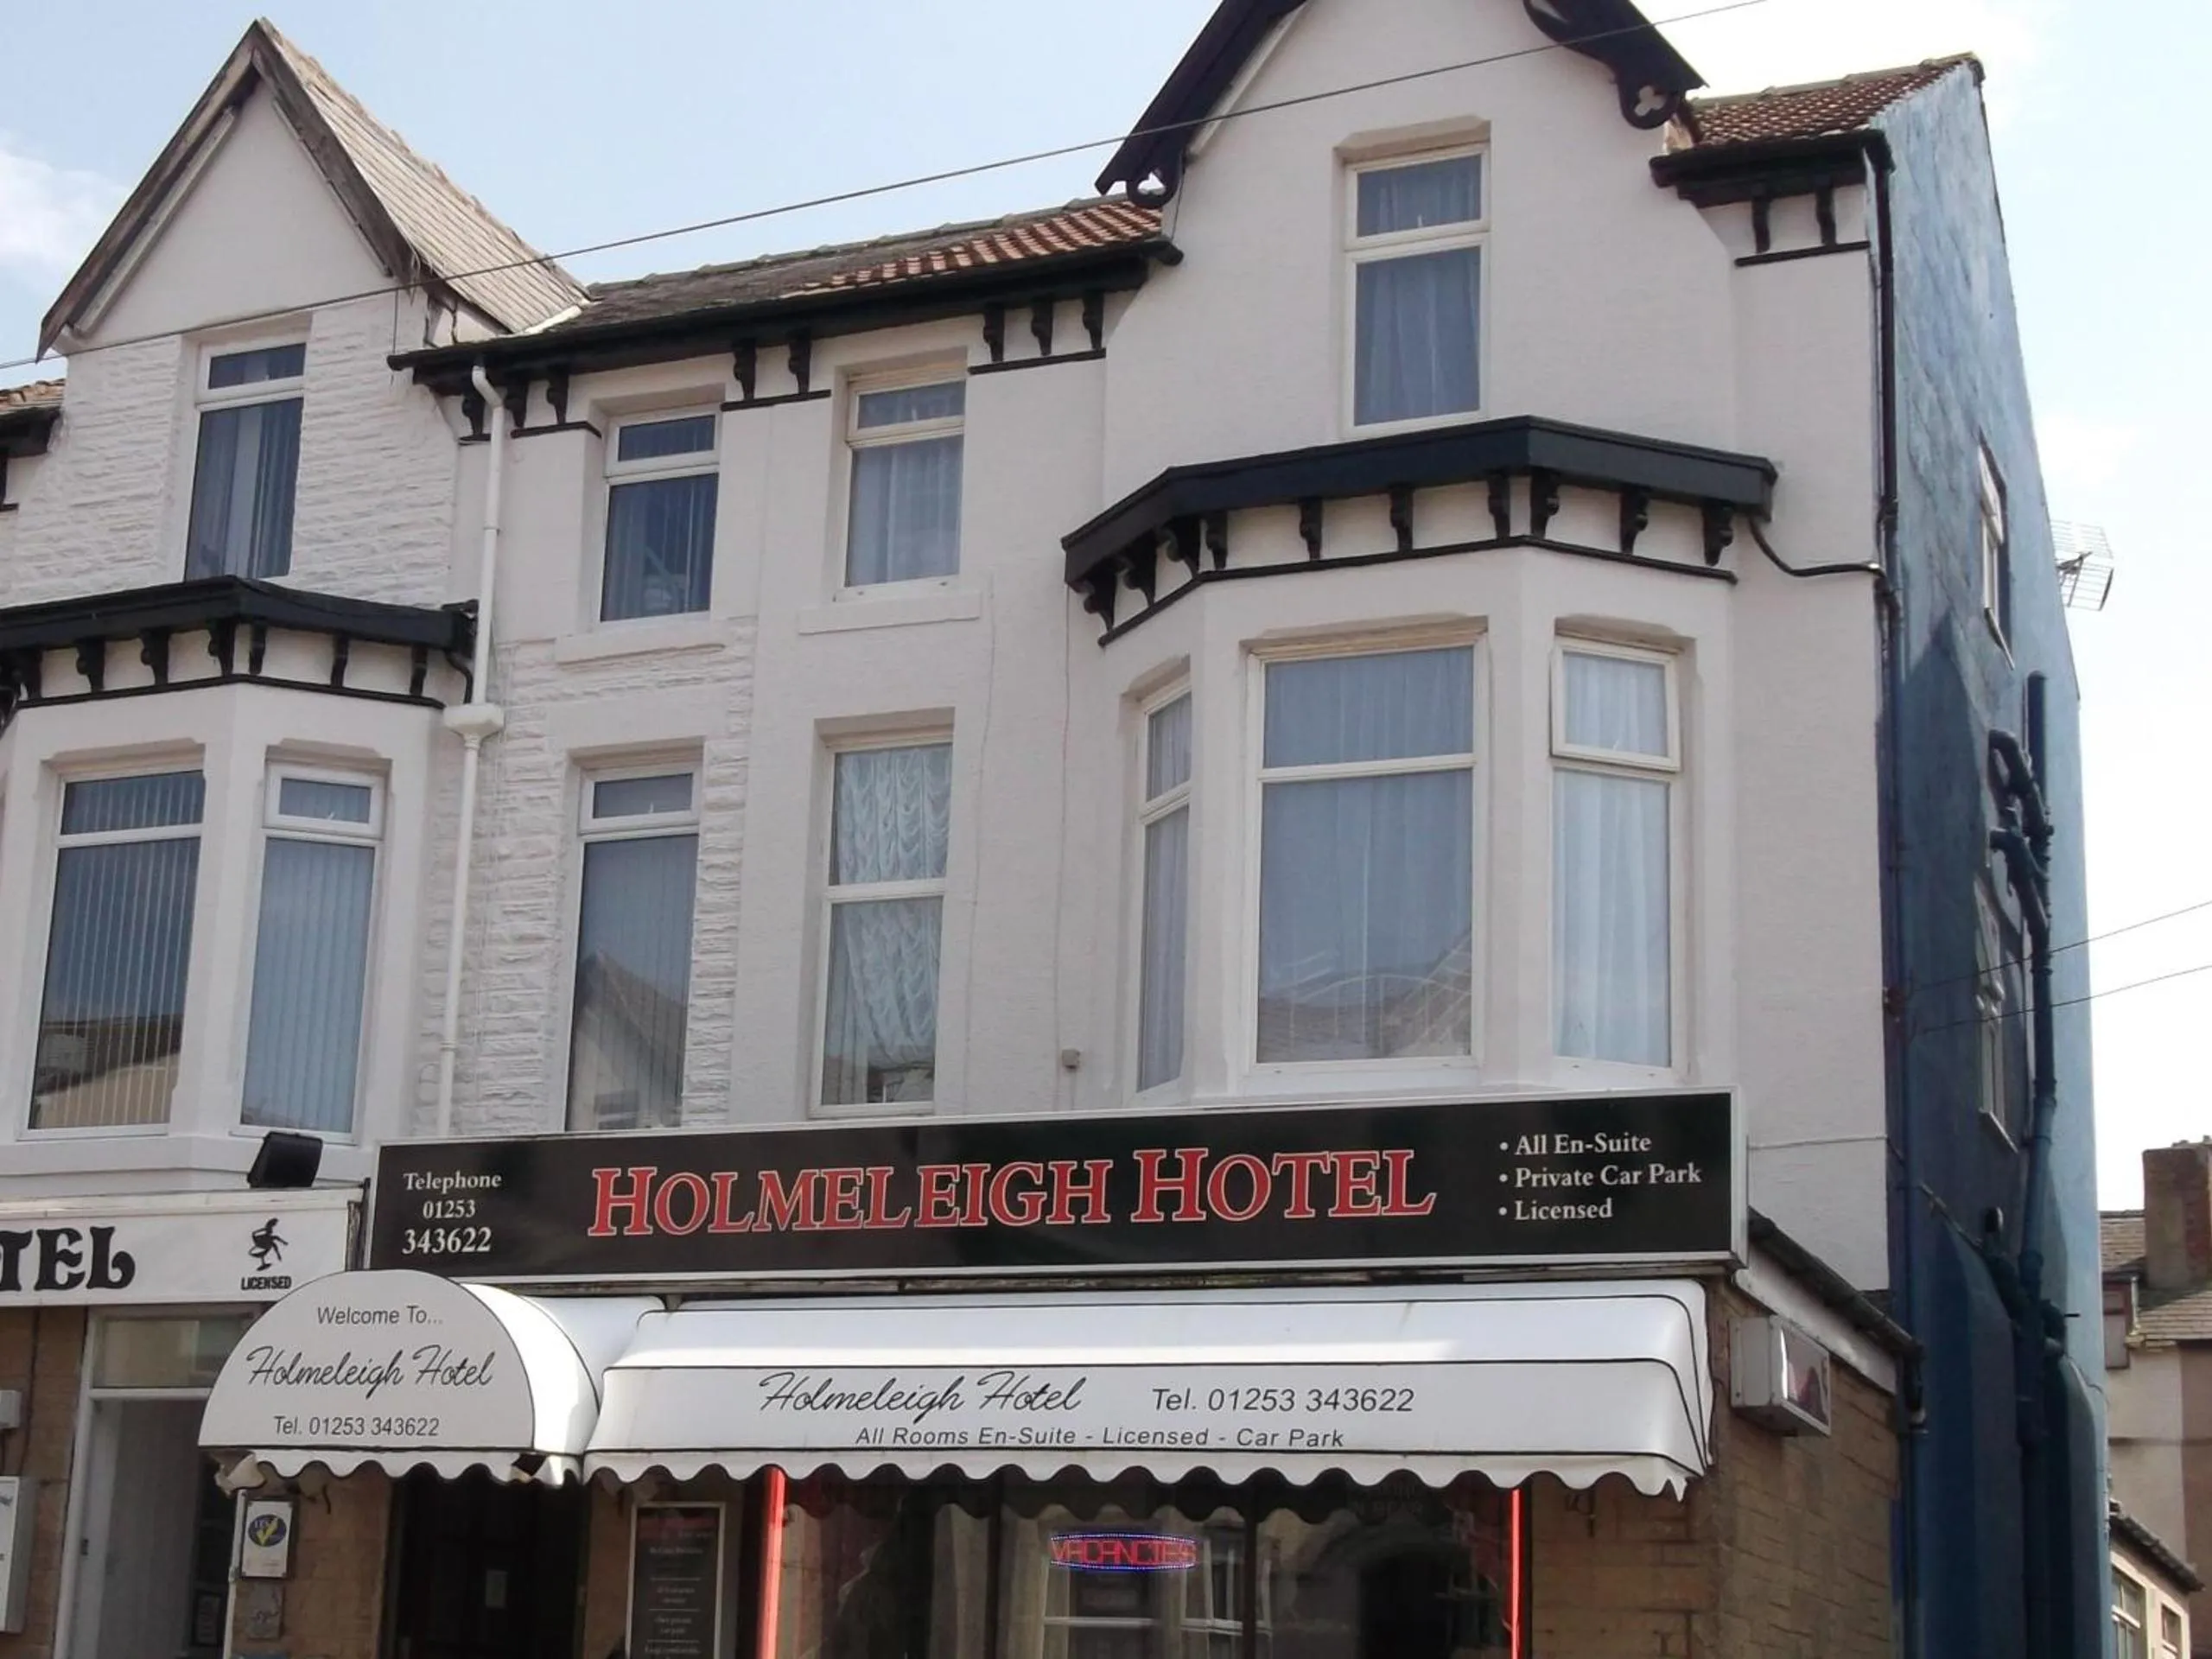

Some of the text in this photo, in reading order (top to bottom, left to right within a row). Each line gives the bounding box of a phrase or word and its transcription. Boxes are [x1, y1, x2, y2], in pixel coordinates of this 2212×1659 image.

[1515, 1132, 1652, 1155] All En-Suite
[403, 1170, 502, 1194] Telephone
[1515, 1162, 1702, 1187] Private Car Park
[588, 1147, 1437, 1236] HOLMELEIGH HOTEL
[423, 1199, 476, 1219] 01253
[1515, 1198, 1612, 1220] Licensed
[402, 1227, 492, 1254] 343622
[240, 1275, 292, 1290] LICENSED
[317, 1306, 399, 1325] Welcome
[246, 1344, 496, 1399] Holmeleigh Hotel
[759, 1370, 1087, 1425] Holmeleigh Hotel
[1153, 1388, 1415, 1412] Tel. 01253 343622
[274, 1415, 440, 1436] Tel. 01253 343622
[855, 1427, 884, 1445] All
[893, 1427, 969, 1445] Rooms
[978, 1427, 1076, 1445] En-Suite
[1103, 1427, 1209, 1445] Licensed
[1236, 1428, 1279, 1446] Car
[1288, 1429, 1344, 1447] Park
[1052, 1540, 1197, 1565] VACANCIES
